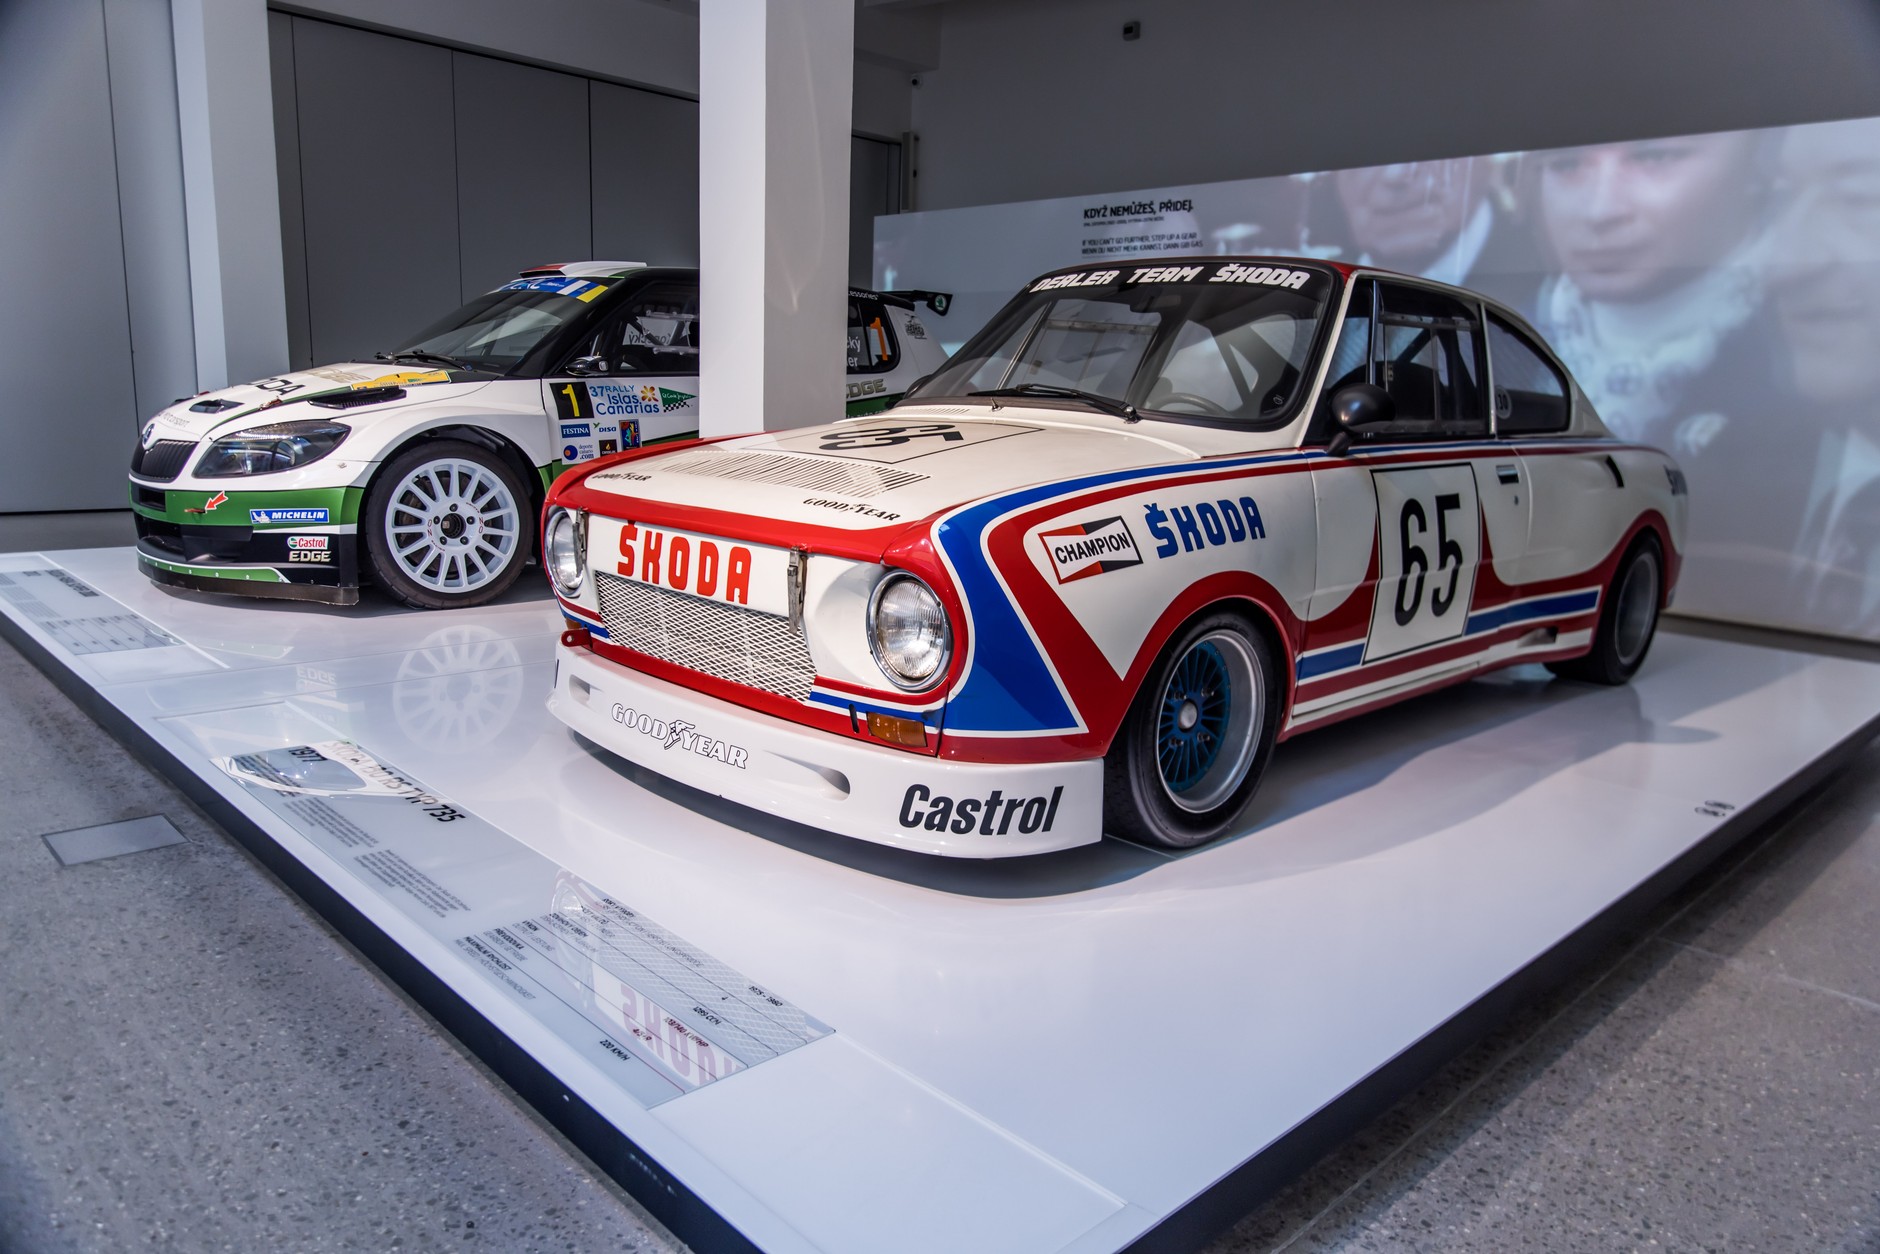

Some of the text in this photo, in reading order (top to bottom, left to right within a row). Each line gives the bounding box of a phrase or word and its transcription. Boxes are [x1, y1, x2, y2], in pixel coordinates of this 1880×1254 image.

[1084, 205, 1107, 219] KDYŽ
[1110, 201, 1156, 217] NEMŮŽEŠ,
[1151, 234, 1166, 242] STEP
[1082, 247, 1098, 255] WENN
[1106, 245, 1123, 253] NICHT
[1124, 244, 1139, 252] MEHR
[1163, 242, 1179, 250] DANN
[1181, 241, 1190, 249] GIB
[1191, 240, 1203, 248] GAS
[1030, 263, 1310, 293] DEALER TEAM ŠKODA
[589, 385, 635, 397] 37 RALLY
[562, 384, 580, 417] 1
[608, 393, 639, 405] Islas
[596, 402, 660, 415] Canarias
[562, 427, 589, 435] FESTINA
[271, 511, 325, 519] MICHELIN
[1143, 496, 1266, 559] ŠKODA
[298, 537, 326, 548] Castrol
[1054, 531, 1131, 565] CHAMPION
[289, 550, 331, 562] EDGE
[617, 519, 752, 605] ŠKODA
[1393, 492, 1463, 627] 65
[288, 746, 328, 762] 1977
[423, 804, 466, 822] 735
[899, 783, 1064, 836] Castrol
[598, 1040, 614, 1048] 220
